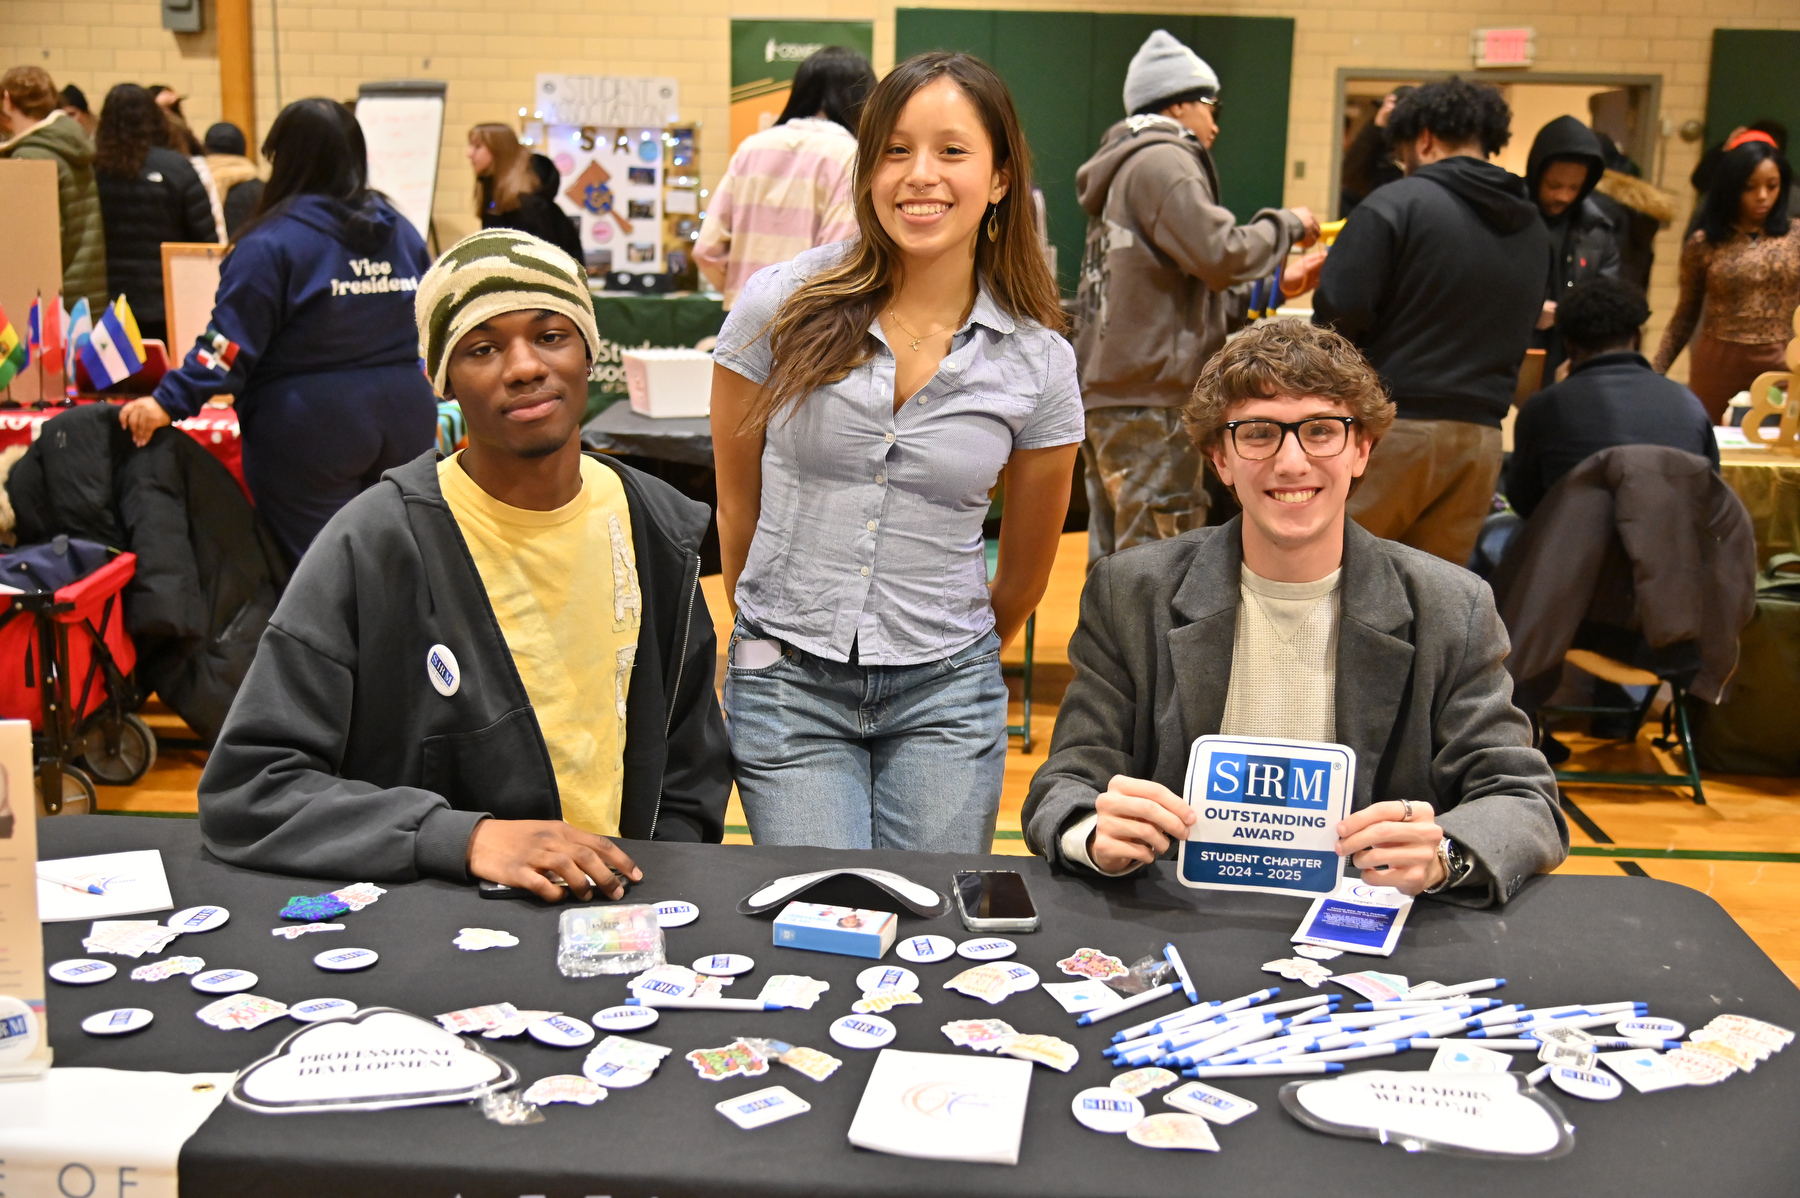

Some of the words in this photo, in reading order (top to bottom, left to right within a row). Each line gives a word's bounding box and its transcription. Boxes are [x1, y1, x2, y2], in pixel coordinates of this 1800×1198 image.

[348, 258, 392, 277] Vice
[1213, 760, 1326, 803] SHRM
[1204, 807, 1327, 828] OUTSTANDING
[1232, 826, 1295, 842] AWARD
[1200, 850, 1260, 864] STUDENT
[1262, 855, 1323, 869] CHAPTER
[1217, 864, 1252, 877] 2024
[1267, 868, 1302, 881] 2025
[842, 1019, 887, 1037] SHRM
[300, 1047, 455, 1064] PROFESSIONAL
[299, 1060, 456, 1076] DEVELOPMENT
[1409, 1085, 1491, 1101] MAJORS
[1083, 1098, 1132, 1113] SHRM
[1374, 1092, 1483, 1117] WELCOME
[57, 1162, 138, 1198] OF
